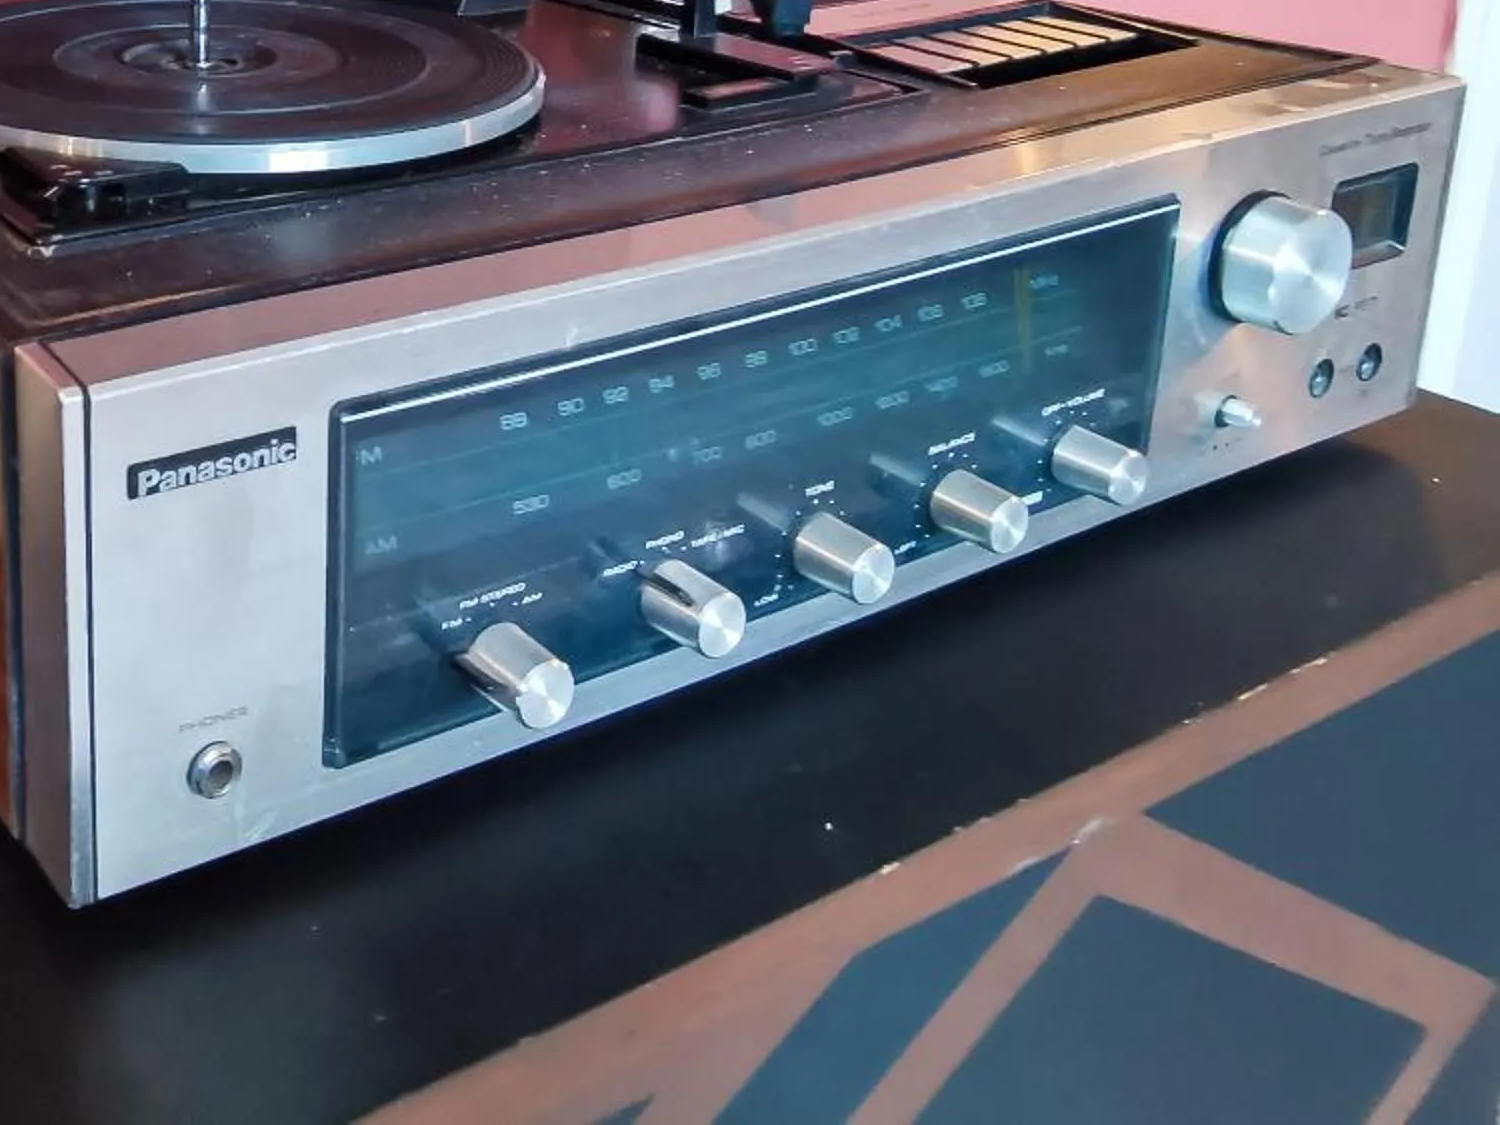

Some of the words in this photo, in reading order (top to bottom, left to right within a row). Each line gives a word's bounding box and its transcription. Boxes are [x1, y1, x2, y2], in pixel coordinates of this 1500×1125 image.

[557, 397, 585, 417] 90
[602, 386, 629, 405] 92
[136, 437, 297, 497] Panasonic
[363, 535, 398, 556] AM
